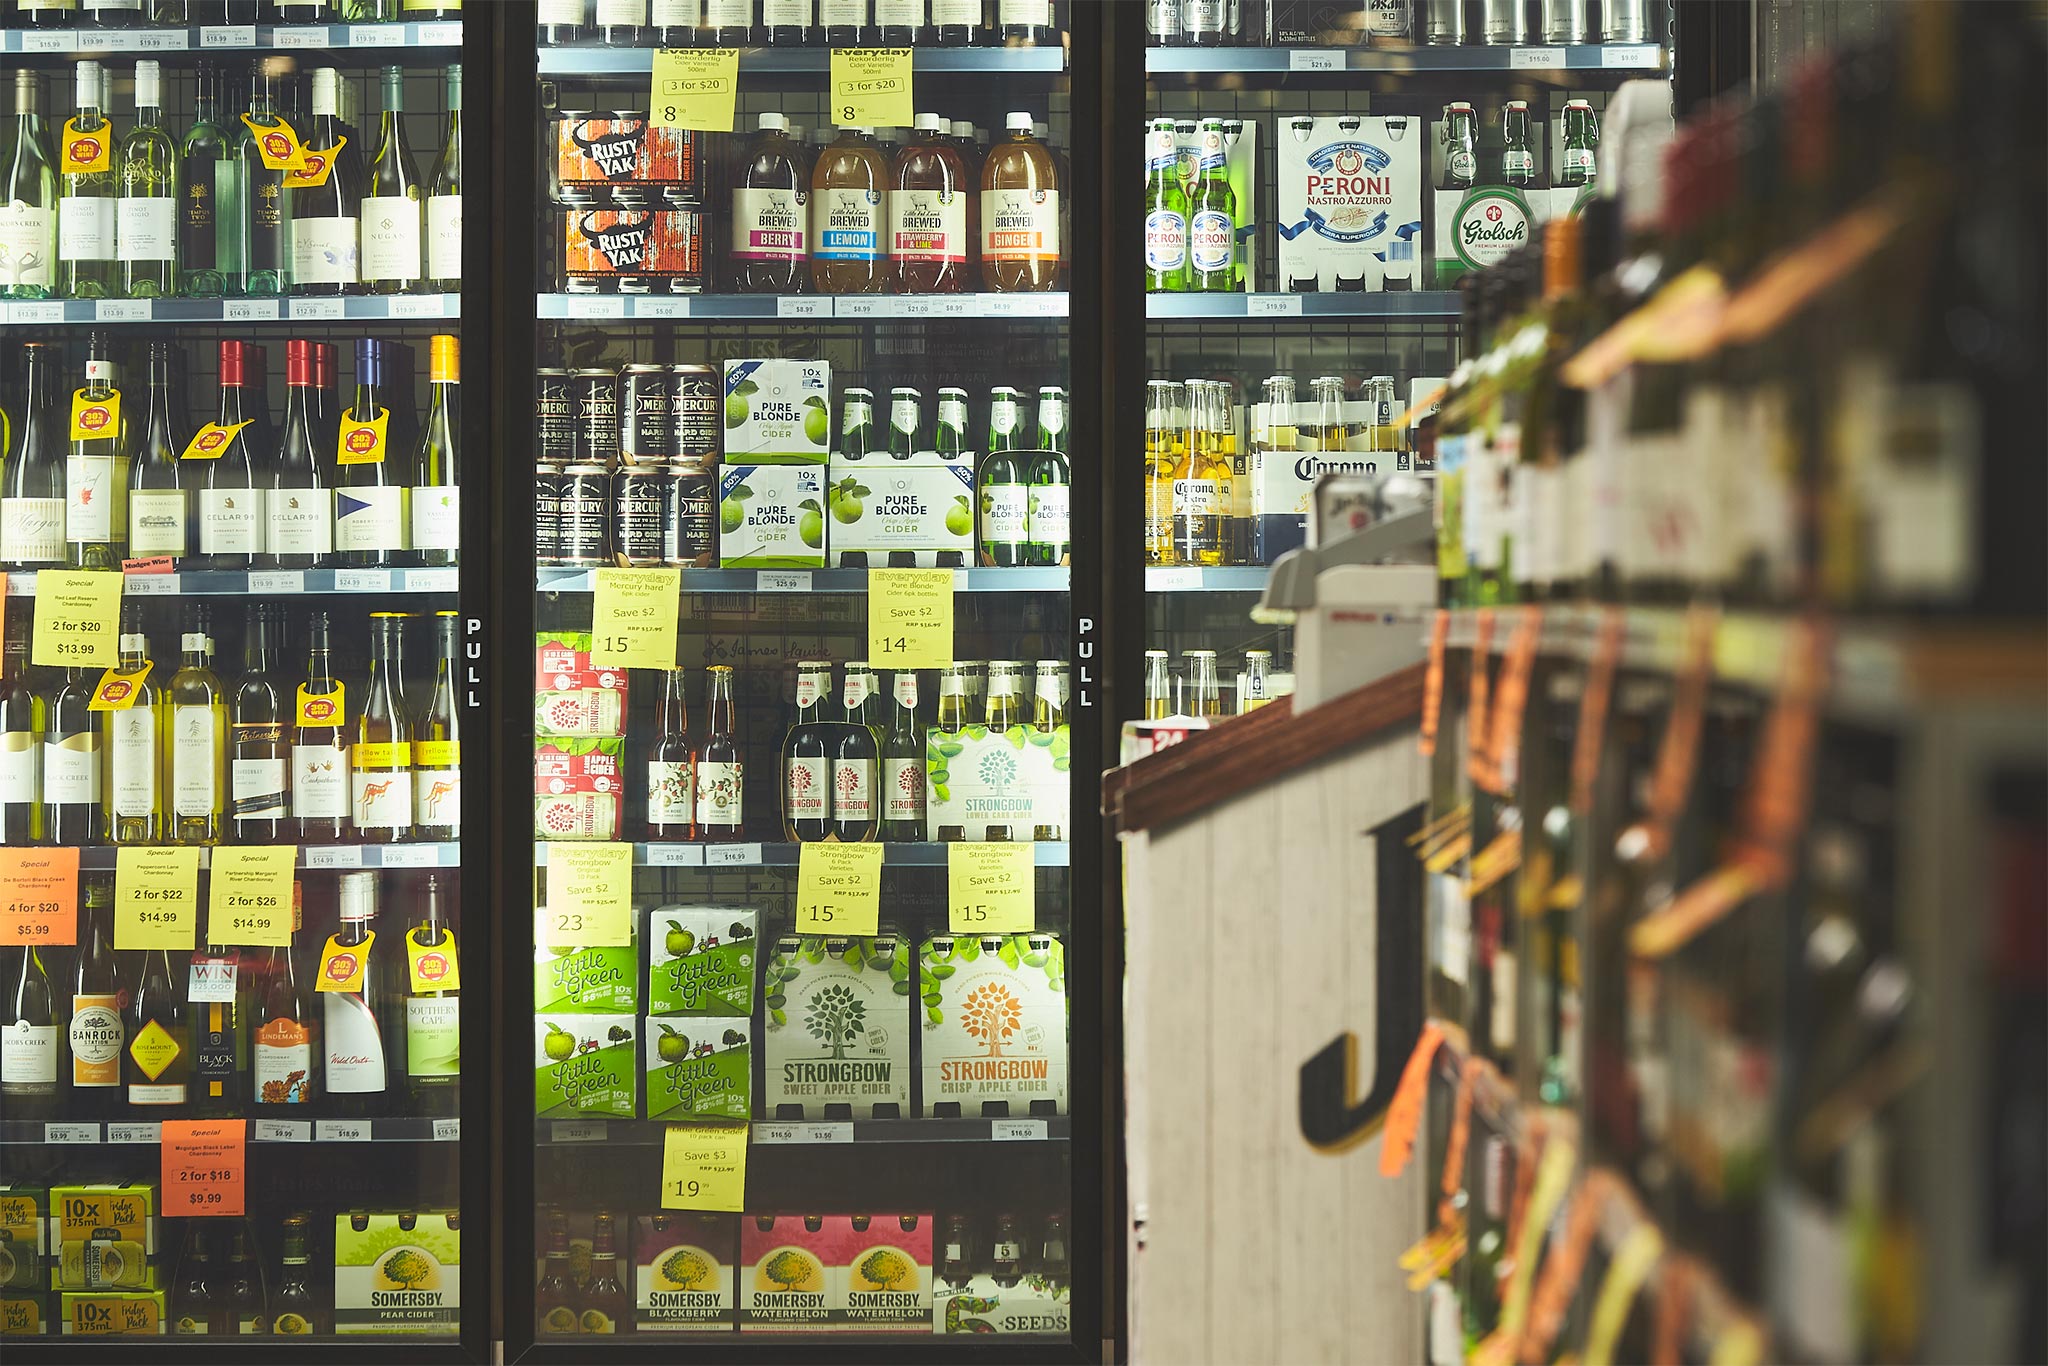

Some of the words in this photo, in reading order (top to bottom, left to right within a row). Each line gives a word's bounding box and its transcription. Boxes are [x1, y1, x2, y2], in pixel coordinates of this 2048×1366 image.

[671, 81, 678, 90] 3
[681, 81, 696, 90] for
[699, 80, 720, 90] $20
[847, 82, 854, 91] 3
[857, 81, 871, 90] for
[875, 80, 896, 90] $20
[664, 106, 676, 121] 8
[843, 106, 855, 120] 8
[591, 139, 638, 161] RUSTY
[600, 158, 636, 177] YAK
[1307, 176, 1390, 195] PERONI
[1307, 196, 1345, 205] NASTRO
[1347, 196, 1392, 205] AZZURRO
[830, 216, 869, 228] BREWED
[902, 217, 941, 228] BREWED
[900, 233, 943, 241] STRAWBERRY
[1319, 228, 1341, 239] BIRRA
[1341, 228, 1380, 240] SUPERIORE
[1463, 220, 1525, 245] Grolsch
[598, 230, 645, 252] RUSTY
[760, 232, 796, 246] BERRY
[830, 233, 868, 246] LEMON
[995, 233, 1034, 247] GINGER
[915, 241, 932, 249] LIME
[606, 249, 643, 268] YAK
[762, 403, 792, 412] PURE
[753, 412, 801, 421] BLONDE
[762, 430, 792, 438] CIDER
[1400, 455, 1407, 464] 6
[1175, 481, 1216, 496] Corona
[885, 495, 918, 505] PURE
[757, 506, 787, 515] PURE
[875, 505, 927, 515] BLONDE
[748, 516, 796, 525] BLONDE
[884, 525, 918, 533] CIDER
[125, 560, 150, 570] Mudgee
[152, 558, 169, 566] Wine
[65, 579, 94, 587] Special
[874, 572, 950, 584] Everyday
[610, 583, 642, 591] Mercury
[644, 583, 663, 591] hard
[891, 582, 908, 590] Pure
[909, 582, 933, 590] Blonde
[613, 609, 639, 618] Save
[642, 608, 655, 617] $2
[890, 608, 916, 618] Save
[919, 607, 932, 616] $2
[52, 622, 59, 631] 2
[61, 621, 78, 631] for
[80, 621, 101, 632] $20
[57, 644, 94, 654] $13.99
[882, 637, 907, 652] 14
[467, 619, 481, 706] PULL
[1079, 618, 1093, 706] PULL
[966, 799, 1033, 811] STRONGBOW
[1014, 811, 1032, 819] CIDER
[820, 851, 865, 860] Strongbow
[969, 851, 1013, 859] Strongbow
[818, 876, 844, 885] Save
[848, 875, 861, 885] $2
[134, 890, 141, 899] 2
[144, 890, 159, 899] for
[162, 890, 182, 900] $22
[228, 897, 235, 905] 2
[238, 897, 254, 905] for
[256, 897, 277, 906] $26
[9, 904, 15, 912] 4
[19, 903, 35, 912] for
[38, 903, 59, 913] $20
[809, 905, 835, 921] 15
[962, 905, 987, 921] 15
[139, 913, 177, 923] $14.99
[233, 918, 270, 929] $14.99
[558, 915, 582, 931] 23
[17, 925, 49, 935] $5.99
[195, 967, 233, 979] WIN
[553, 952, 607, 986] Little
[566, 967, 623, 1003] Green
[409, 1006, 456, 1017] SOUTHERN
[421, 1016, 445, 1025] CAPE
[73, 1030, 120, 1040] BANROCK
[200, 1054, 233, 1063] BLACK
[330, 1053, 348, 1064] Wild
[784, 1062, 892, 1082] STRONGBOW
[940, 1060, 1048, 1081] STRONGBOW
[783, 1083, 817, 1096] SWEET
[824, 1083, 856, 1096] APPLE
[861, 1082, 891, 1094] CIDER
[941, 1081, 972, 1094] CRISP
[978, 1081, 1011, 1093] APPLE
[1017, 1080, 1048, 1092] CIDER
[684, 1151, 710, 1161] Save
[713, 1151, 726, 1160] $3
[180, 1171, 187, 1181] 2
[190, 1171, 207, 1181] for
[210, 1170, 231, 1182] $18
[675, 1181, 700, 1197] 19
[190, 1193, 222, 1205] $9.99
[65, 1199, 100, 1218] 10x
[110, 1199, 133, 1213] Fridge
[66, 1218, 101, 1227] 375mL
[113, 1211, 136, 1225] Pack
[649, 1309, 720, 1318] BLACKBERRY
[750, 1309, 828, 1318] WATERMELON
[846, 1309, 924, 1318] WATERMELON
[1005, 1316, 1067, 1330] SEEDS
